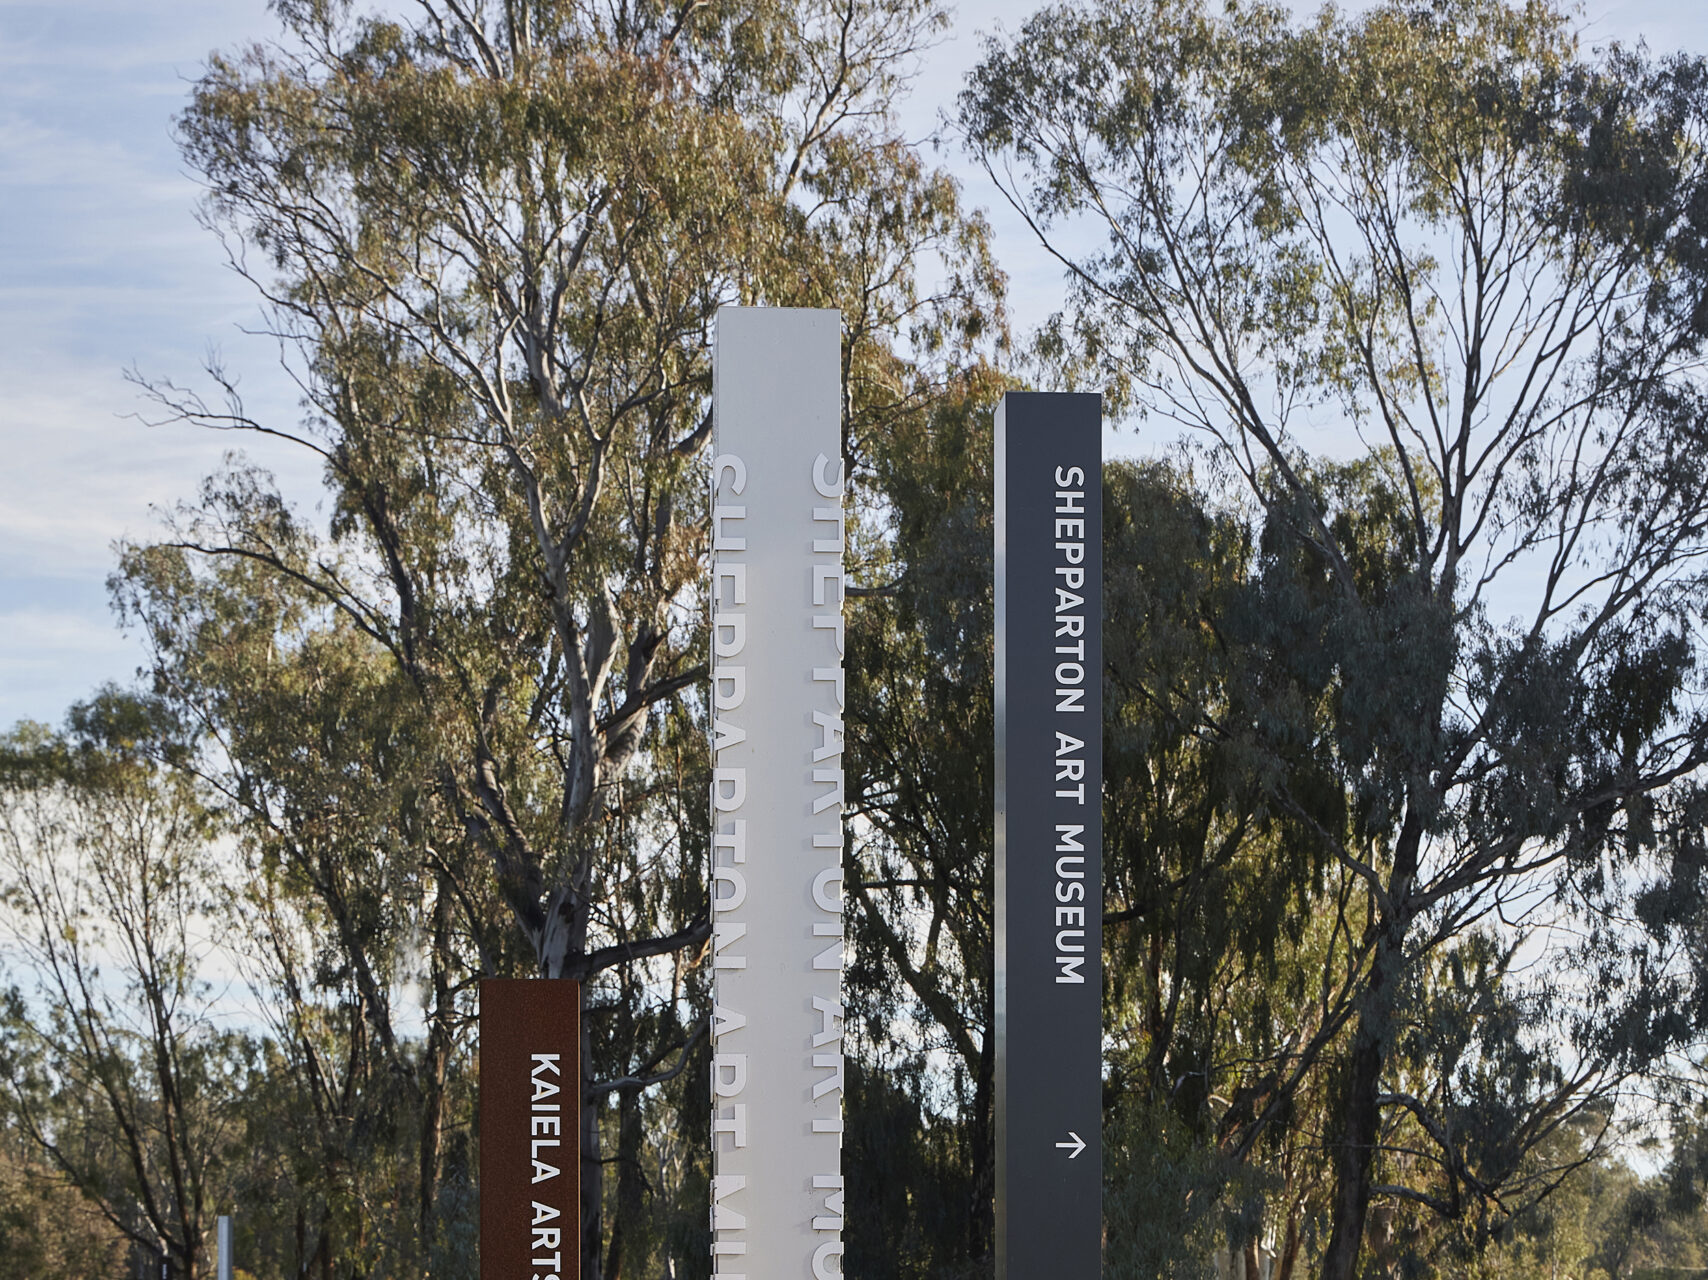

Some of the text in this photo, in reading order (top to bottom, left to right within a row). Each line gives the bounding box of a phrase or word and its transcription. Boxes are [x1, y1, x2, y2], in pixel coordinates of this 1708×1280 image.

[1054, 465, 1085, 984] SHEPPARTON ART MUSEUM
[531, 1053, 561, 1185] KAIELA
